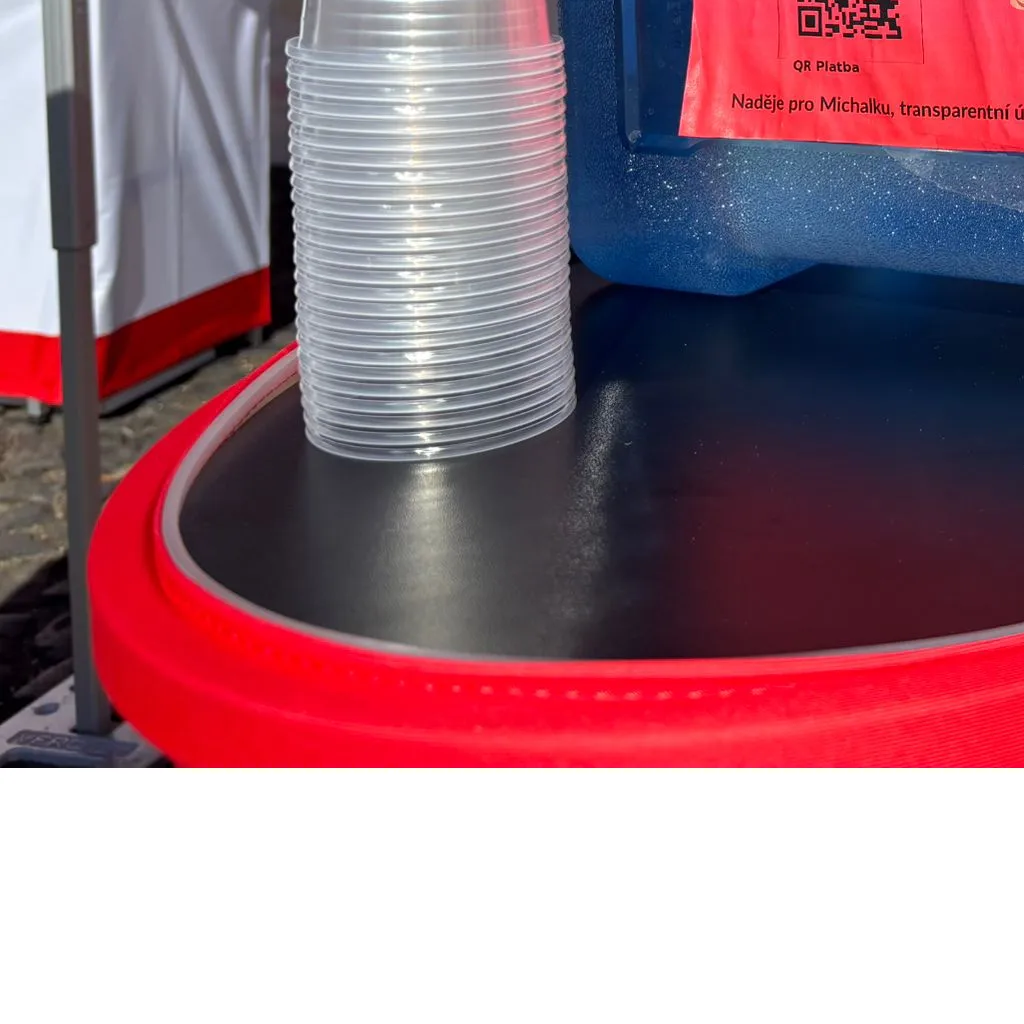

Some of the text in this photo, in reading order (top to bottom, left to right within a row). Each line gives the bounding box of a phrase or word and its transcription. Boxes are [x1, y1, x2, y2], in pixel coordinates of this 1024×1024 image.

[793, 60, 860, 73] QR Platba
[731, 93, 785, 114] Naděje
[788, 99, 815, 114] pro
[820, 96, 895, 118] Michalku,
[900, 101, 1011, 120] transparentní
